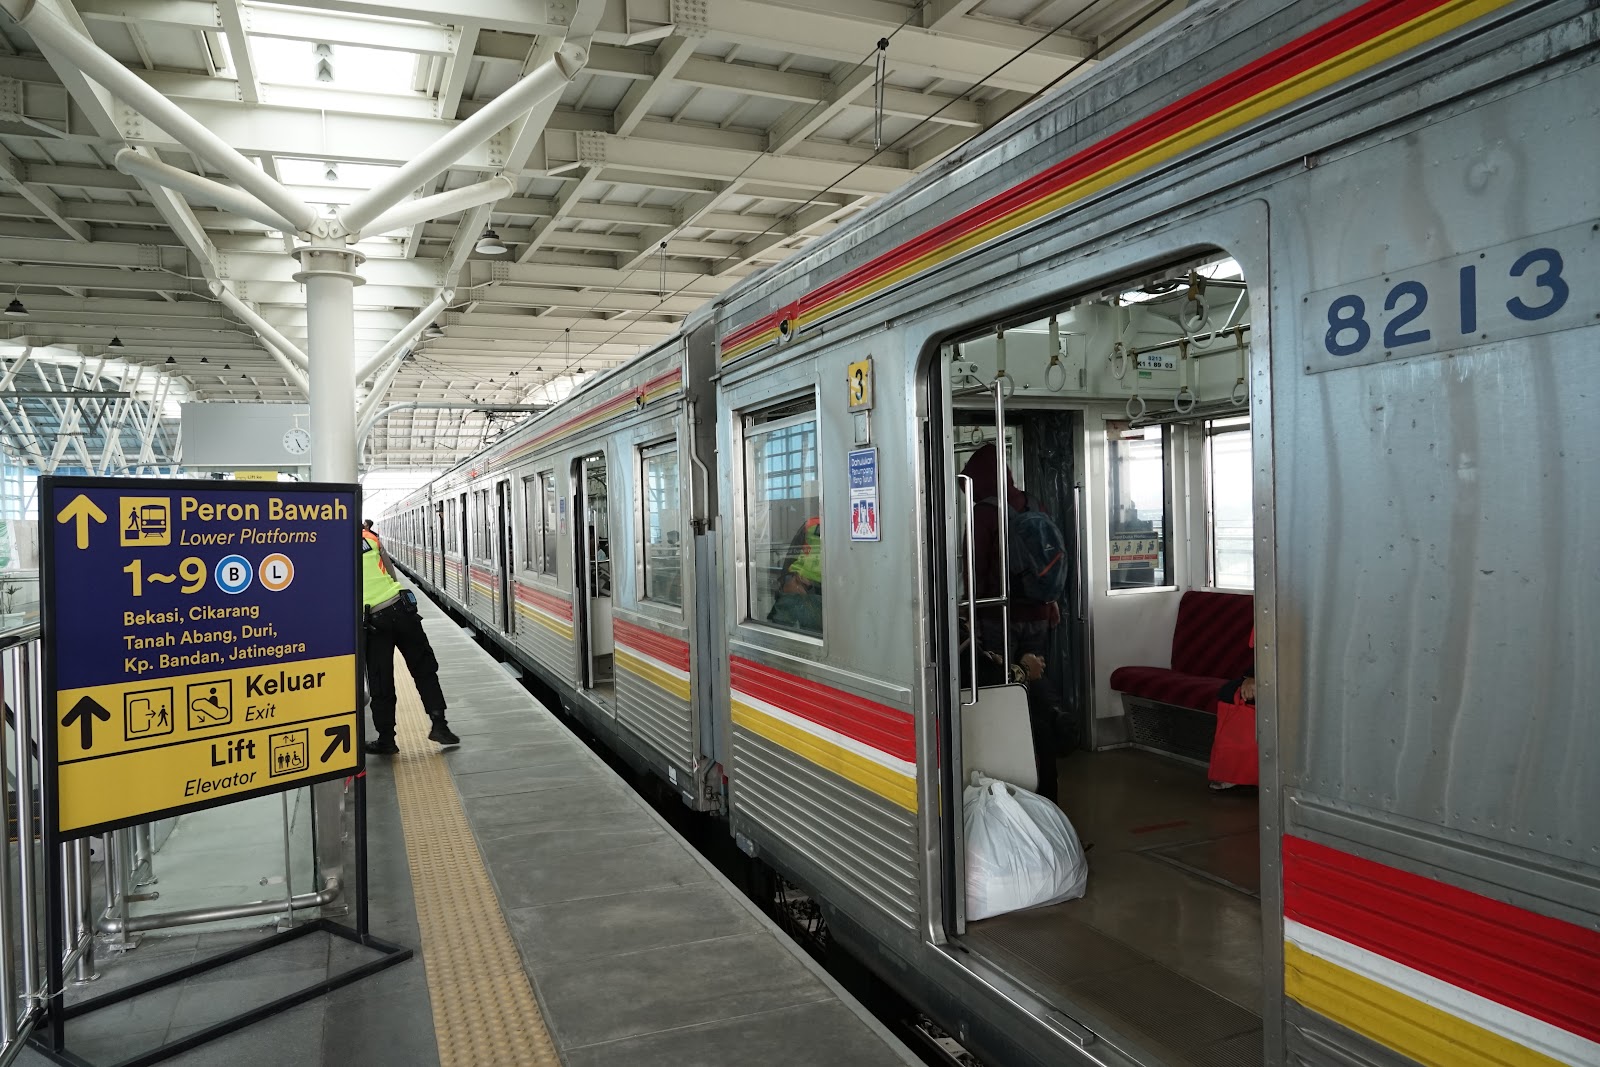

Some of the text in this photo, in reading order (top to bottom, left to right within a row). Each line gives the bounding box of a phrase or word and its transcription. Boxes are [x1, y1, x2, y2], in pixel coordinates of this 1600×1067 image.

[1325, 248, 1570, 356] 8213
[855, 368, 864, 401] 3
[851, 457, 873, 467] Dahulukan
[851, 467, 874, 475] Penumpang
[180, 496, 348, 522] Peron Bawah
[179, 527, 317, 546] Lower Platforms
[123, 556, 282, 597] 1~9 B L
[123, 605, 260, 627] Bekasi, Cikarang
[123, 622, 278, 651] Tanah Abang, Duri,
[124, 642, 306, 675] Kp. Bandan, Jatinegara
[246, 670, 326, 698] Keluar
[245, 702, 277, 722] Exit
[211, 738, 256, 767] Lift
[184, 770, 257, 797] Elevator
